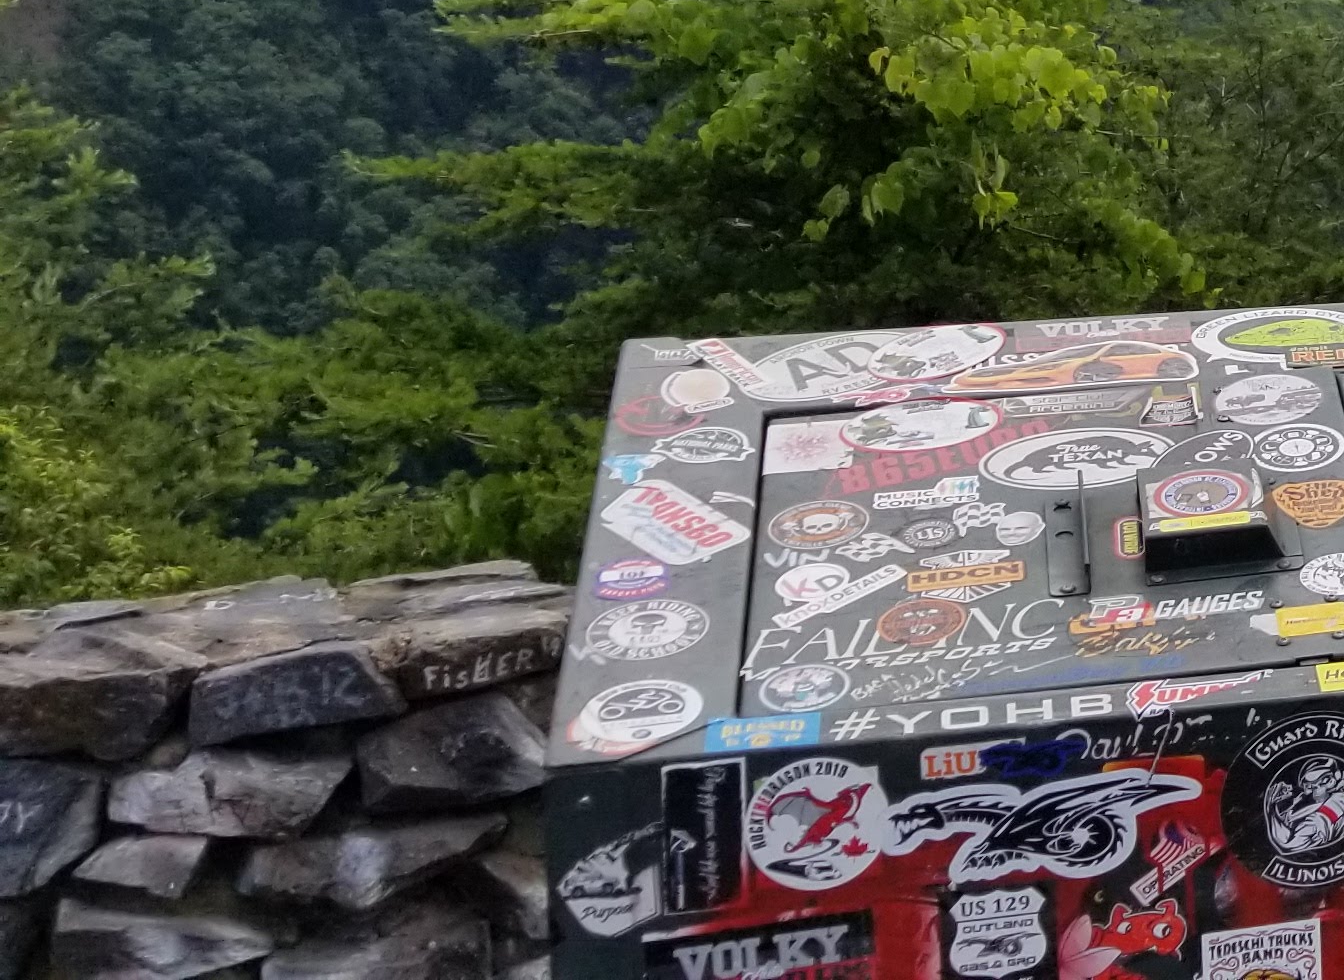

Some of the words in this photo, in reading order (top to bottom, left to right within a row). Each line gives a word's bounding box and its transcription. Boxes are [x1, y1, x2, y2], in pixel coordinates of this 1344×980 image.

[1249, 309, 1309, 319] LIZARD
[1036, 317, 1169, 338] VOLKY
[1049, 450, 1123, 463] TEXAN
[877, 494, 977, 508] CONNECTS
[878, 490, 934, 501] MUSIC
[911, 563, 1021, 585] HDCN
[646, 600, 702, 622] RIDING
[1153, 590, 1265, 621] GAUGES
[1254, 721, 1319, 761] Guard
[961, 901, 986, 917] US
[993, 895, 1030, 914] 129
[673, 924, 849, 980] VOLKY
[1208, 936, 1265, 961] TEDESCHI
[1267, 931, 1315, 950] TRUCKS
[1242, 949, 1283, 965] BAND
